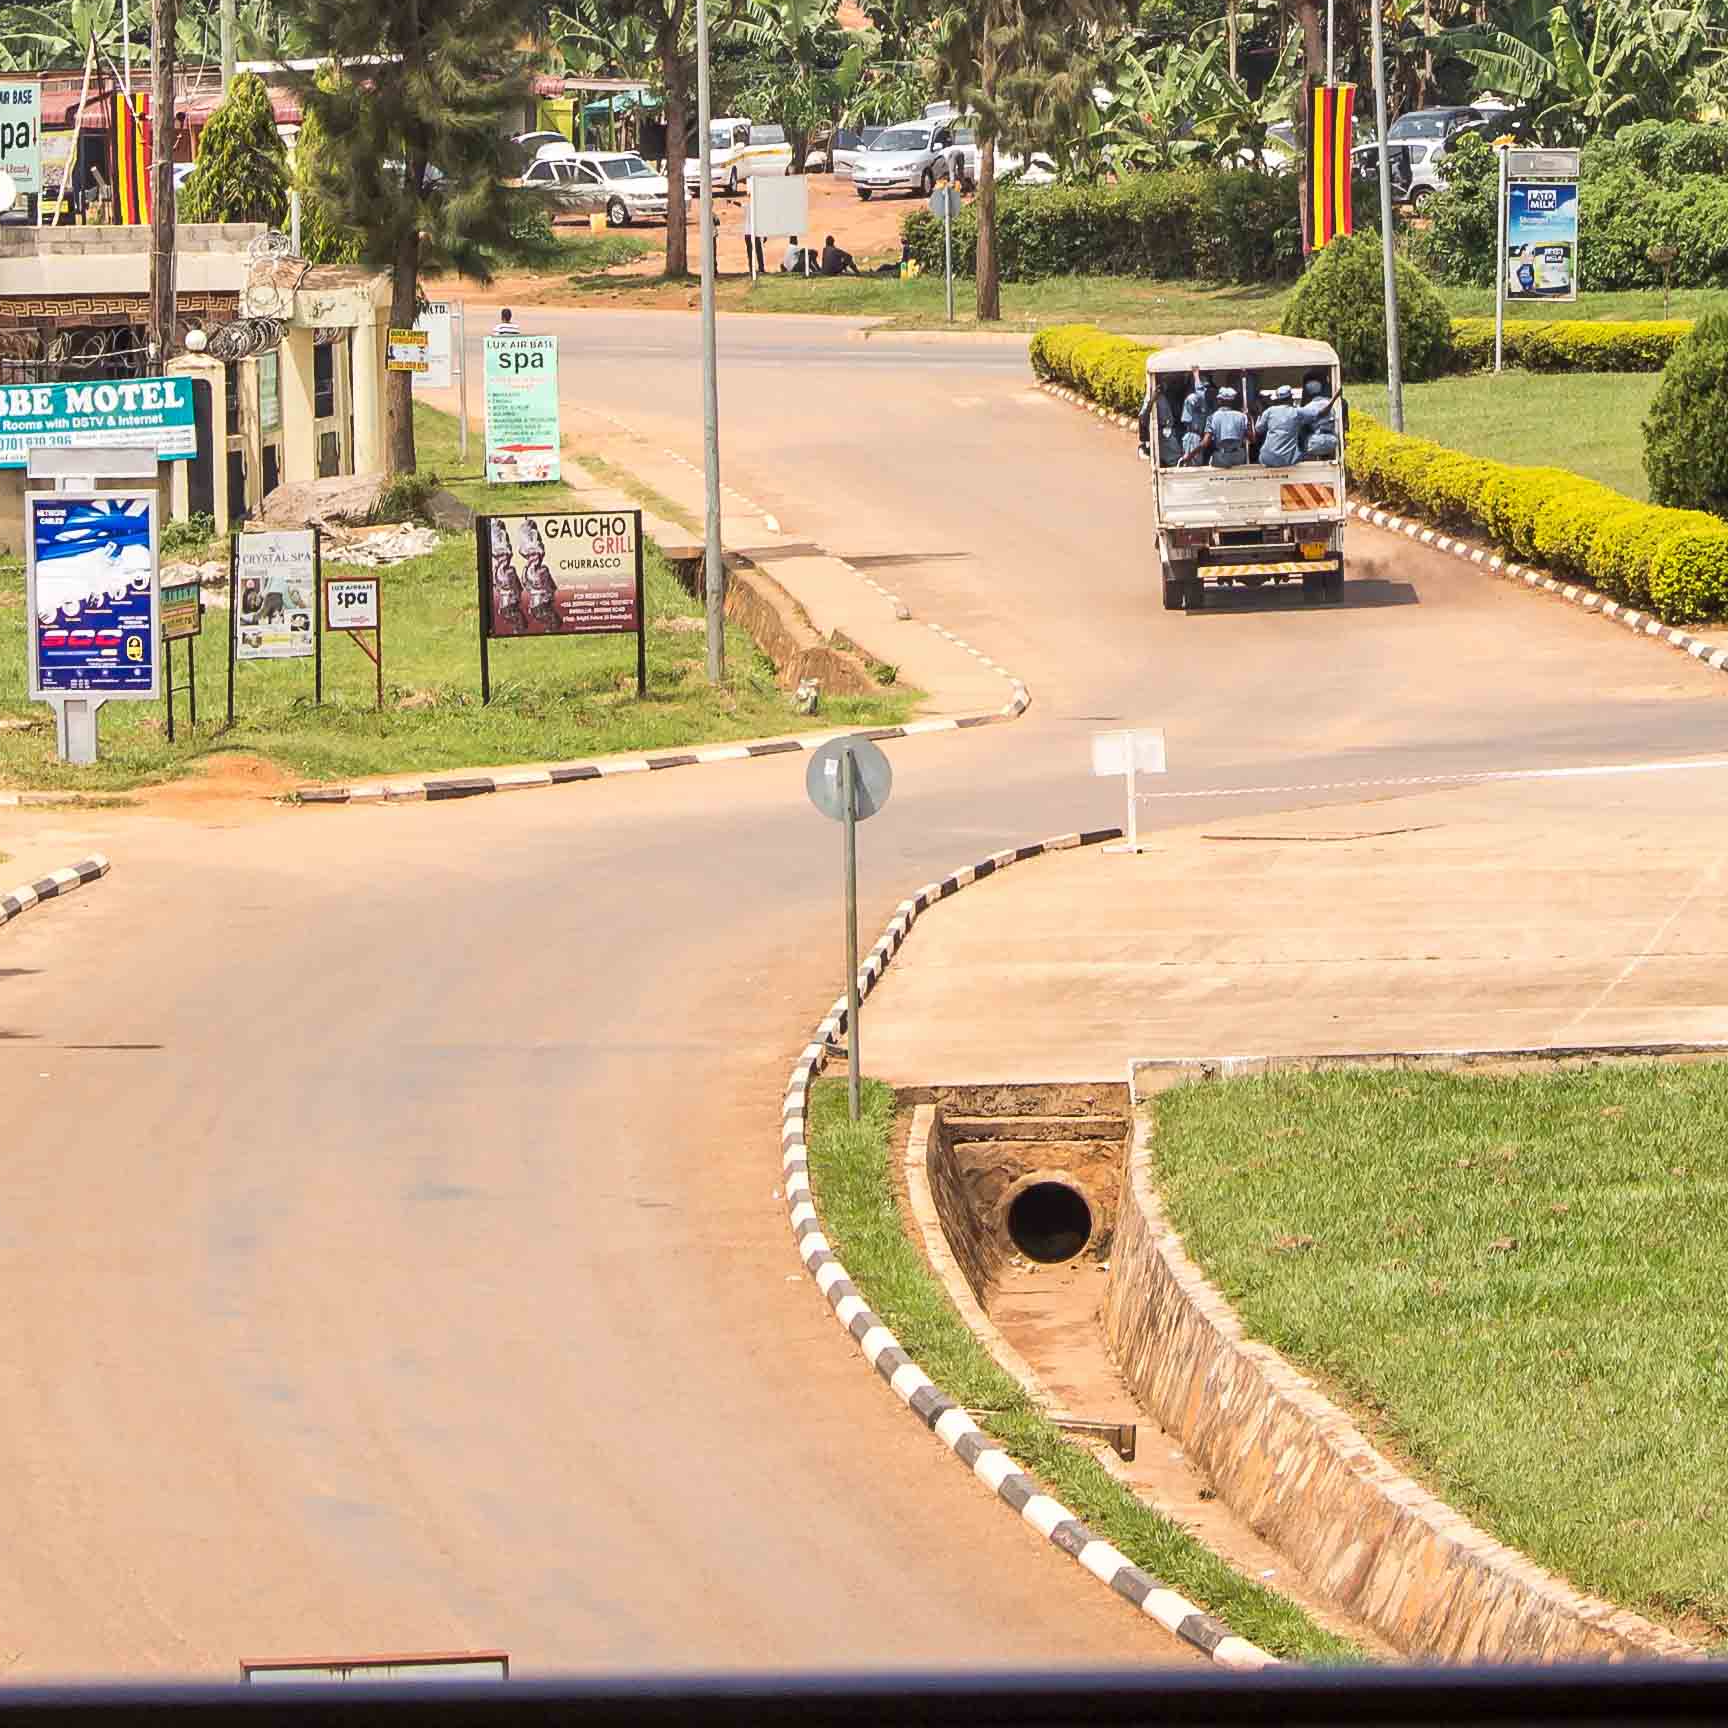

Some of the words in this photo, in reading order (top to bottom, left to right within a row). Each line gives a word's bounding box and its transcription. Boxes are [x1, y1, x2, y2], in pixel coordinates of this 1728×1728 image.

[13, 89, 32, 105] BASE
[498, 352, 544, 374] spa
[65, 382, 185, 415] MOTEL
[3, 419, 43, 431] Rooms
[45, 417, 70, 429] with
[72, 416, 104, 428] DSTV
[107, 414, 116, 426] &
[118, 413, 164, 426] Internet
[544, 517, 626, 541] GAUCHO
[592, 535, 634, 555] GRILL
[242, 551, 289, 565] CRYSTAL
[291, 551, 311, 562] SPA
[559, 557, 621, 570] CHURRASCO
[337, 592, 368, 608] spa
